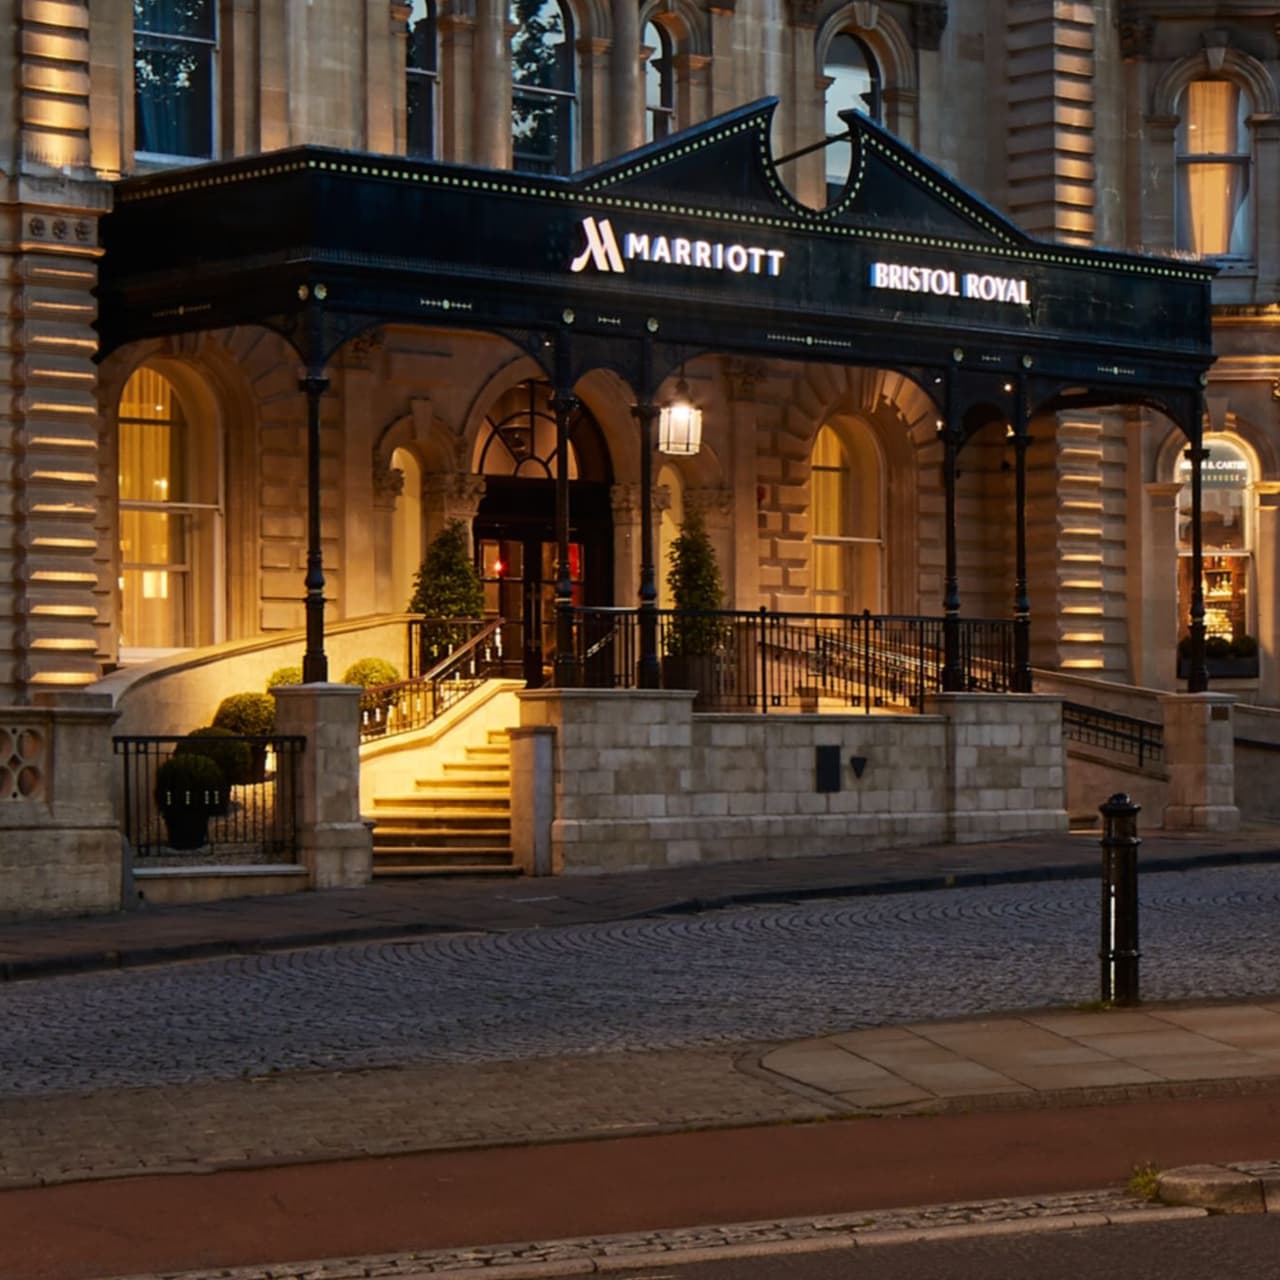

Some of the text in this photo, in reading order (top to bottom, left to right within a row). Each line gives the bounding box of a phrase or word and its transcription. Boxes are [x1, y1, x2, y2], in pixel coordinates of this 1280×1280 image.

[624, 232, 785, 276] MARRIOTT
[871, 262, 1031, 305] BRISTOL ROYAL
